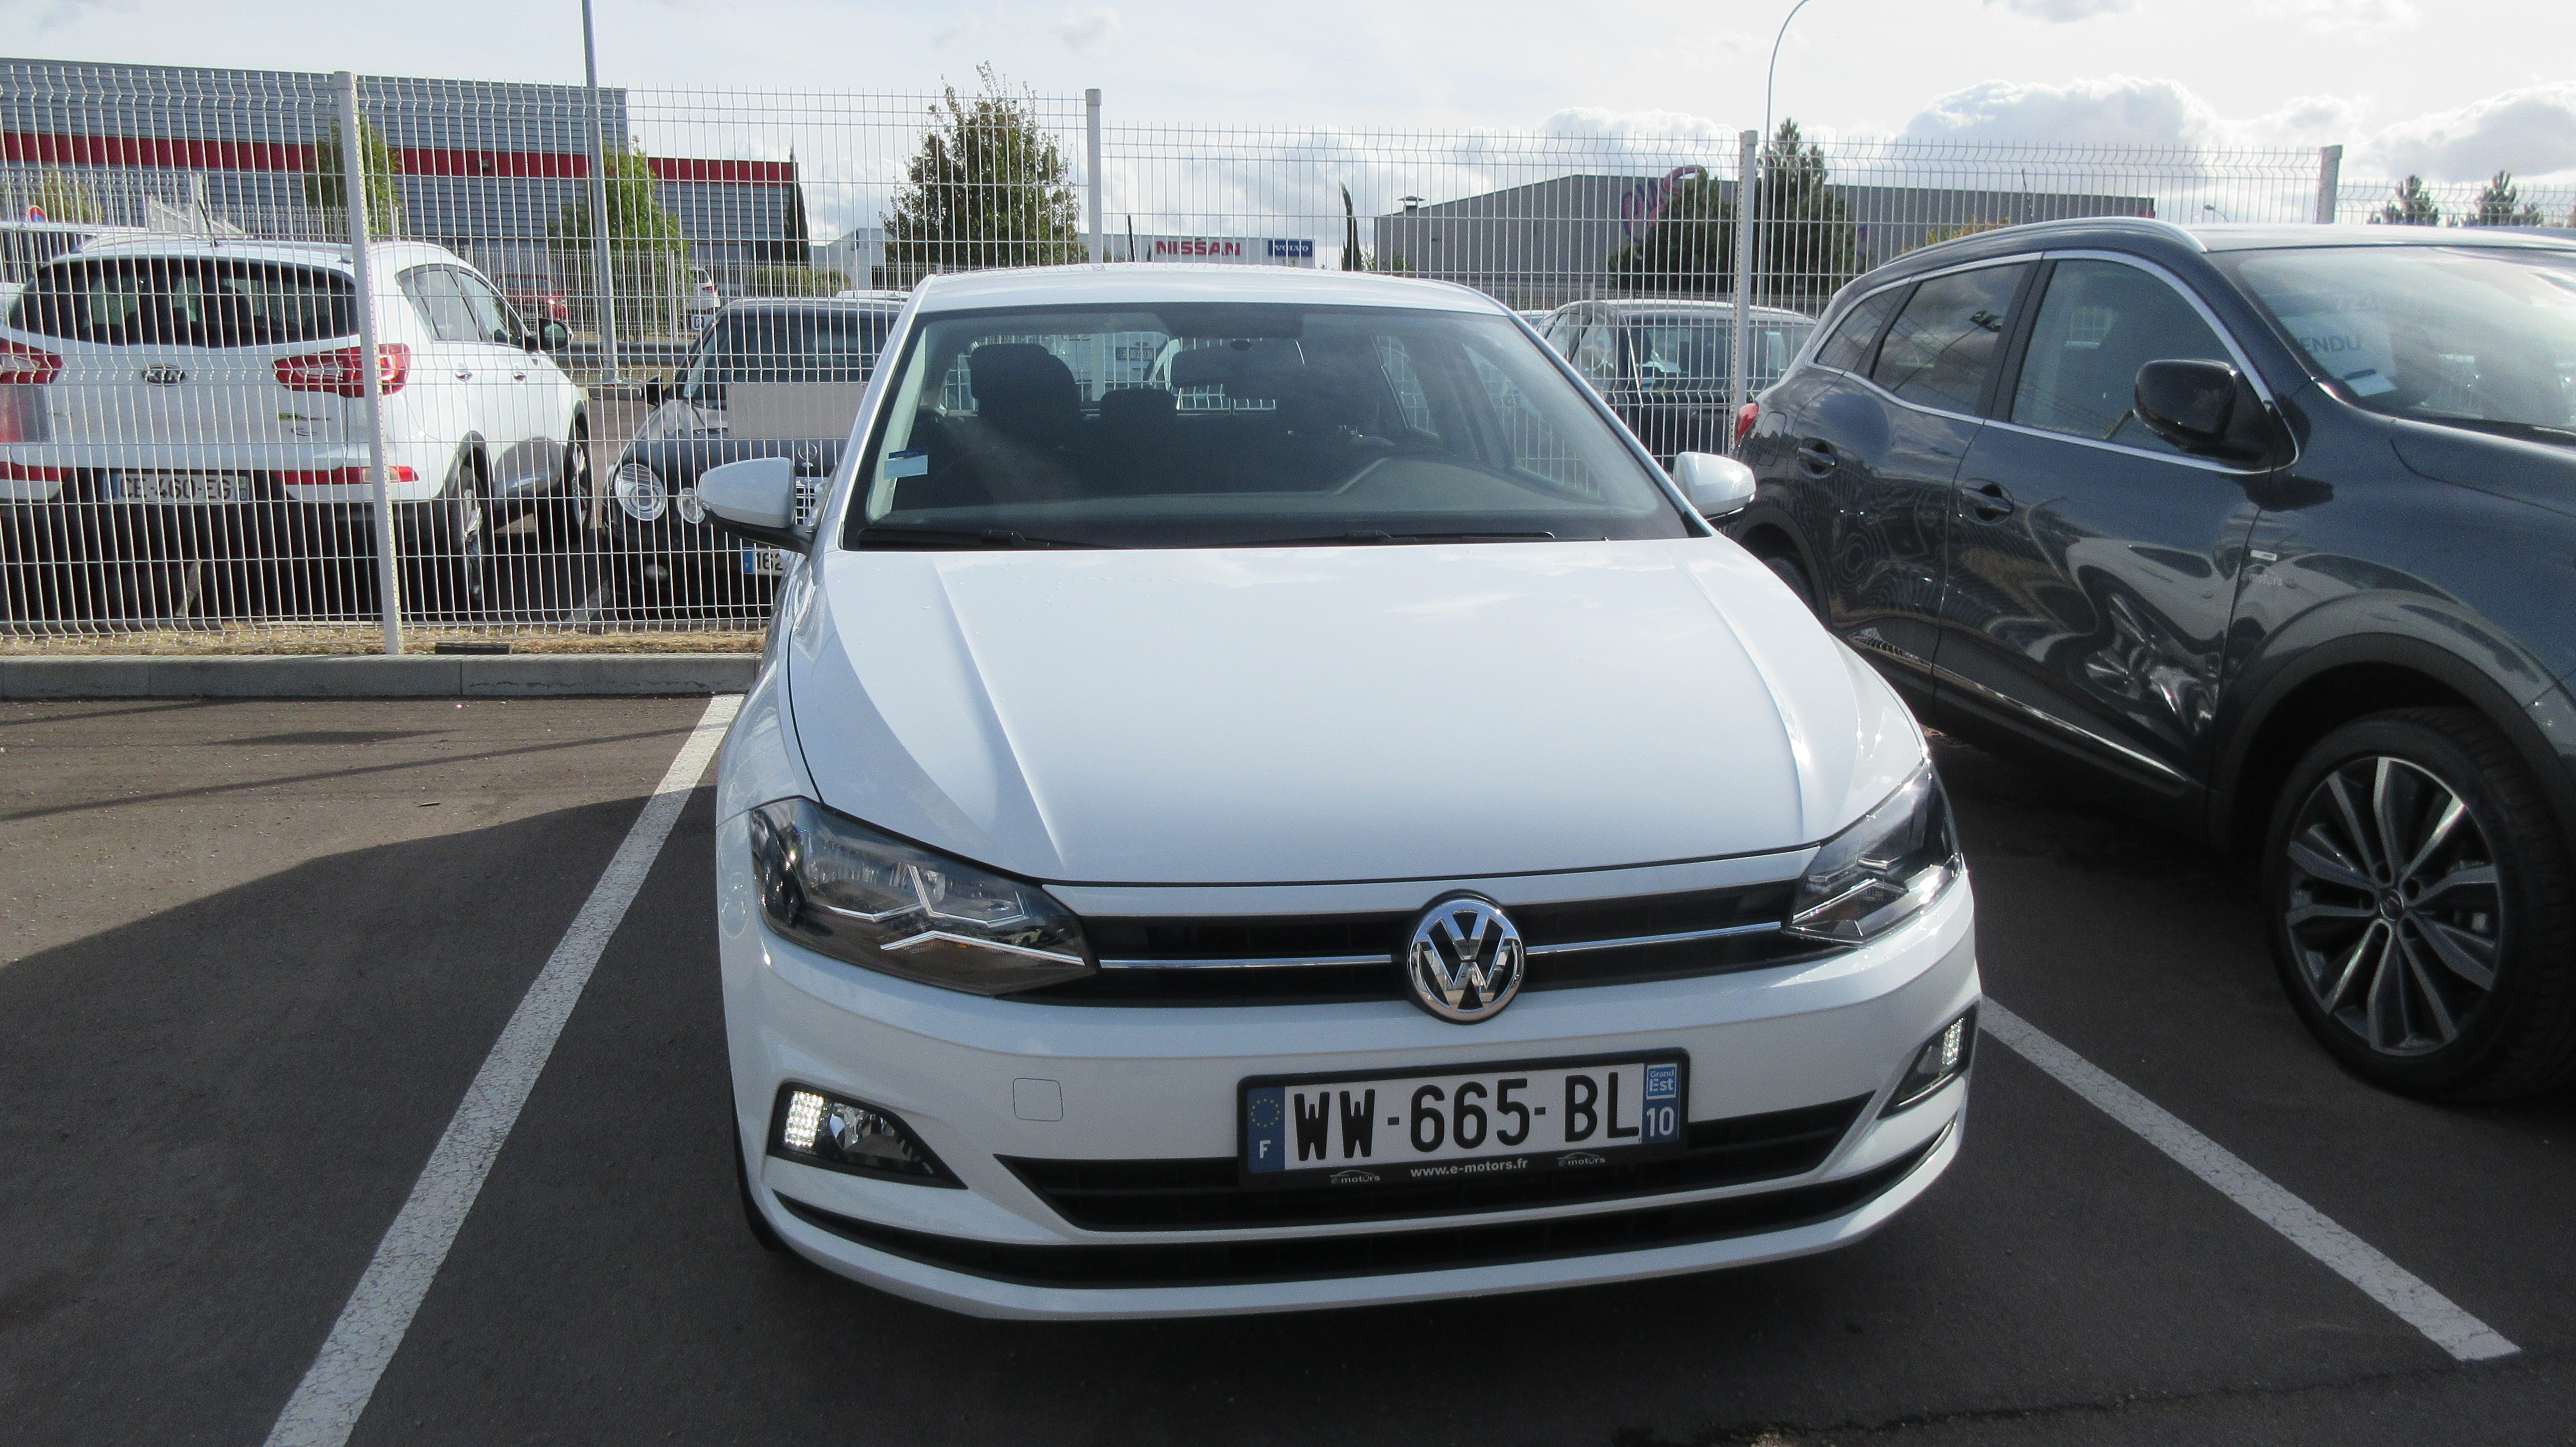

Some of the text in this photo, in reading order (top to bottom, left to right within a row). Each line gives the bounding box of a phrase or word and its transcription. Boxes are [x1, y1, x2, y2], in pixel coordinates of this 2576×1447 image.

[1156, 241, 1241, 256] NISSAN
[2298, 333, 2361, 353] ENDU
[1650, 1069, 1674, 1078] Grand
[1649, 1078, 1674, 1092] Est
[1294, 1072, 1640, 1161] WW-665-BL
[1646, 1107, 1675, 1137] 10
[1259, 1139, 1271, 1159] F
[1410, 1158, 1529, 1177] www.e-motors.fr
